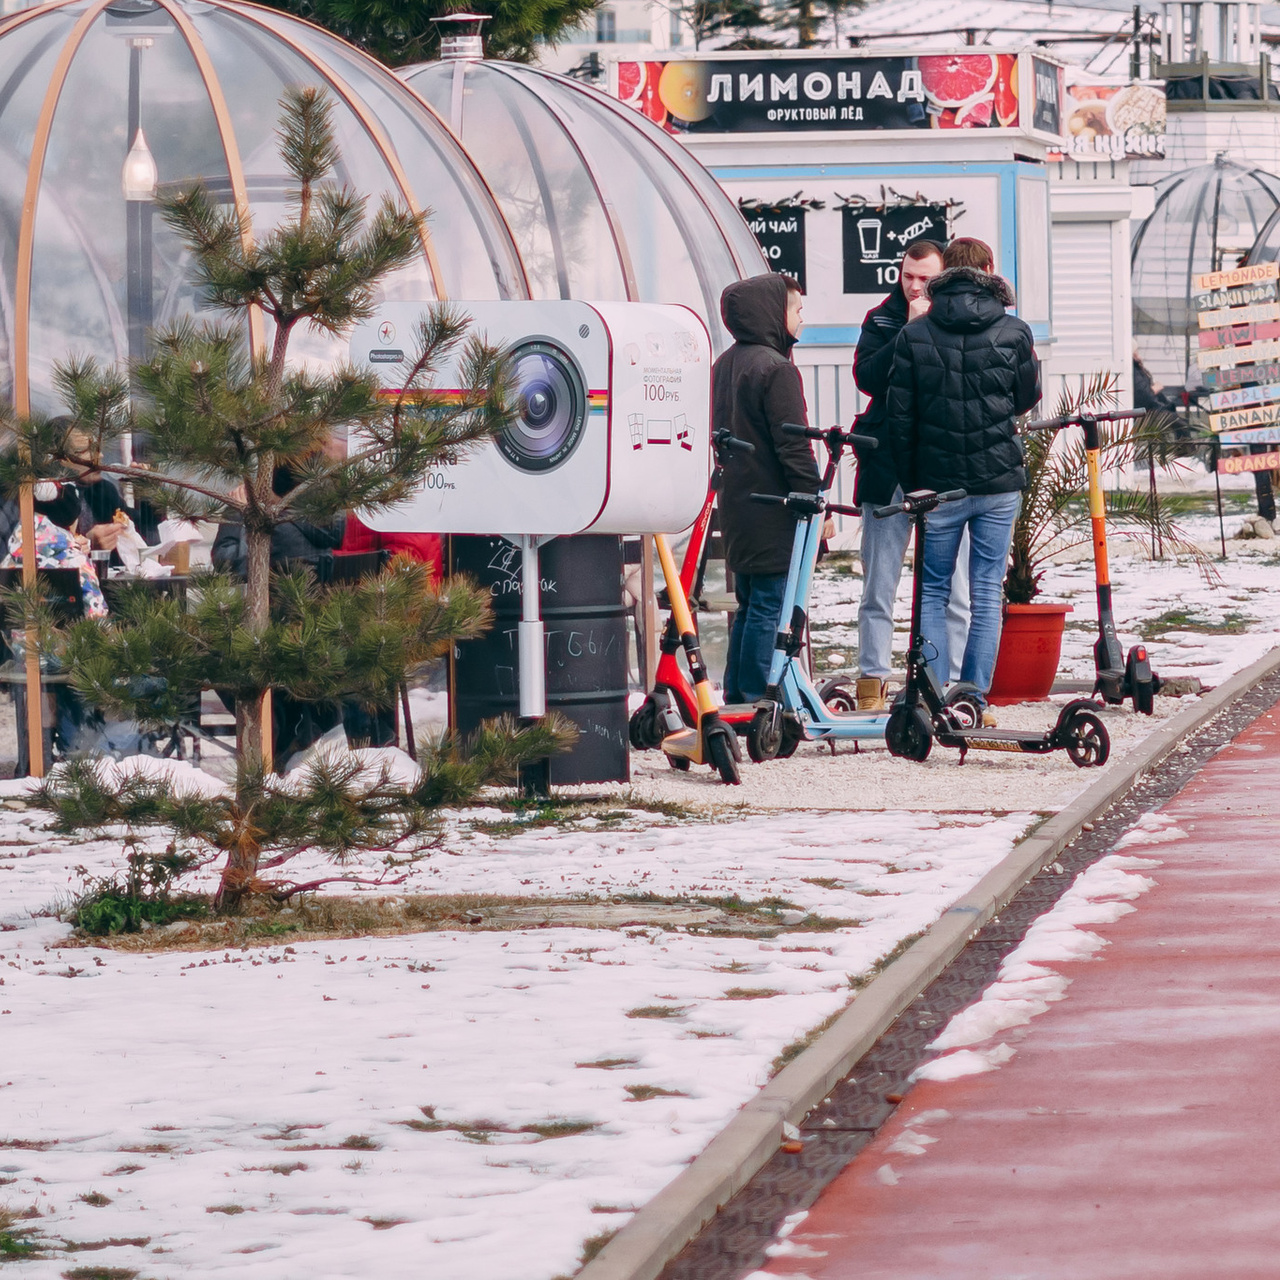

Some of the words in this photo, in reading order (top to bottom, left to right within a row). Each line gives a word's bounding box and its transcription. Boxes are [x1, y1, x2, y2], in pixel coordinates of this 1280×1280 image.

[707, 71, 925, 103] ЛИМОНАД
[767, 107, 837, 121] ФРУКТОВЫЙ
[840, 106, 864, 120] ЛЁД
[769, 217, 798, 233] ЧАЙ
[1201, 265, 1273, 289] LEMONADE
[643, 375, 682, 383] ФОТОГРАФИЯ
[1220, 364, 1279, 384] LEMON
[1221, 386, 1271, 406] APPLE
